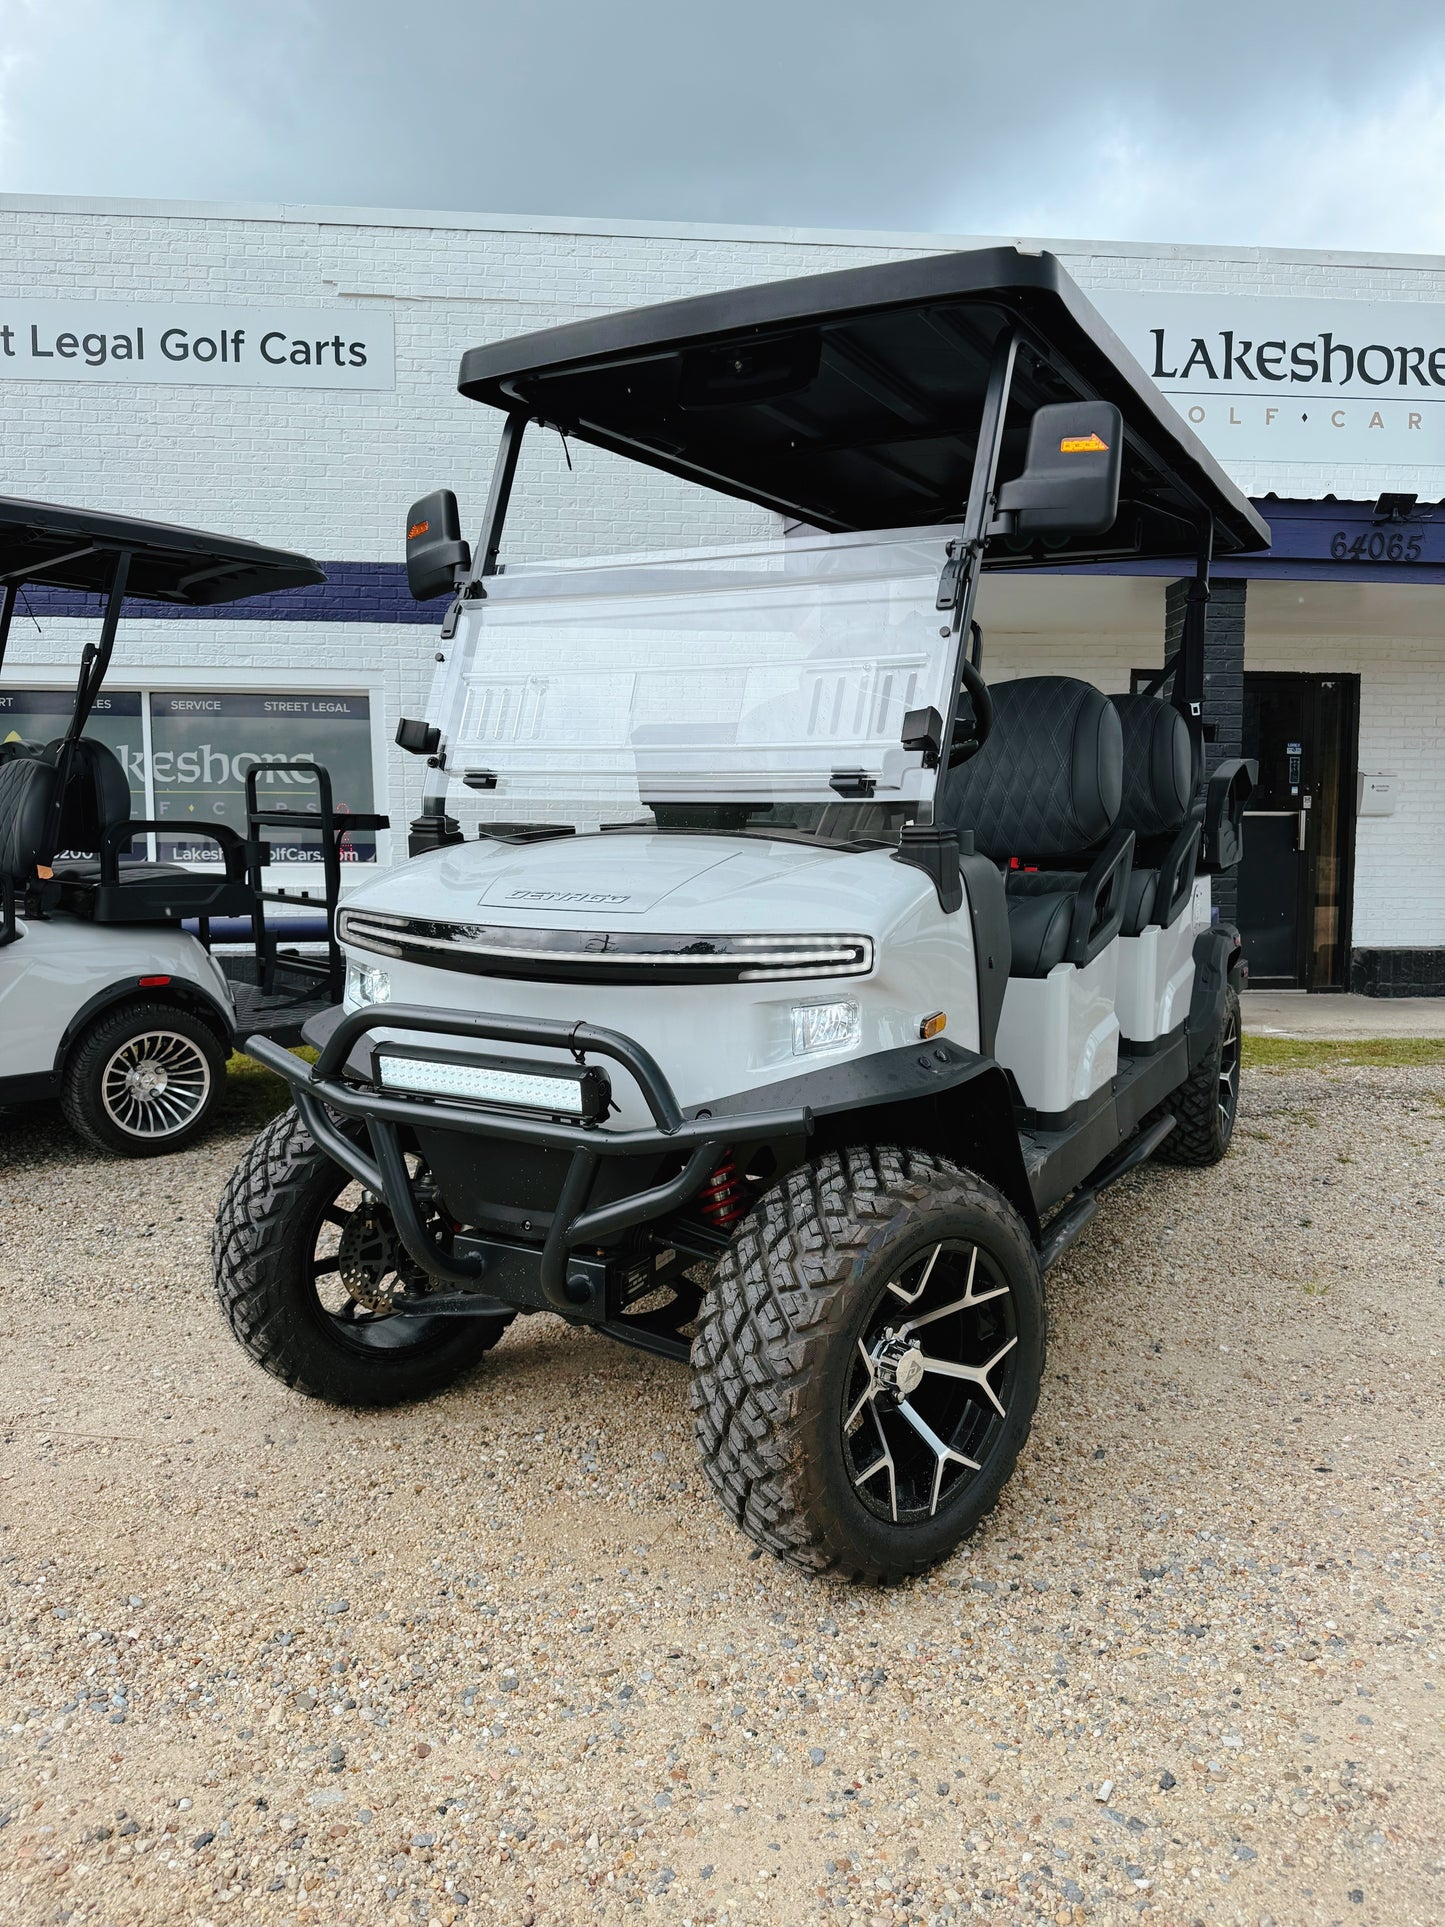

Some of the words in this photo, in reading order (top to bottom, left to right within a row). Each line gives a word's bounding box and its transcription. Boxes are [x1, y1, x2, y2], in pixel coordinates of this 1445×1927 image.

[31, 325, 144, 366] Legal
[160, 328, 245, 363] Golf
[260, 331, 368, 367] Carts
[1188, 406, 1279, 425] OLF
[1330, 531, 1423, 561] 64065
[170, 700, 222, 711] SERVICE
[264, 701, 309, 712] STREET
[312, 702, 351, 713] LEGAL
[115, 744, 317, 784] keshore
